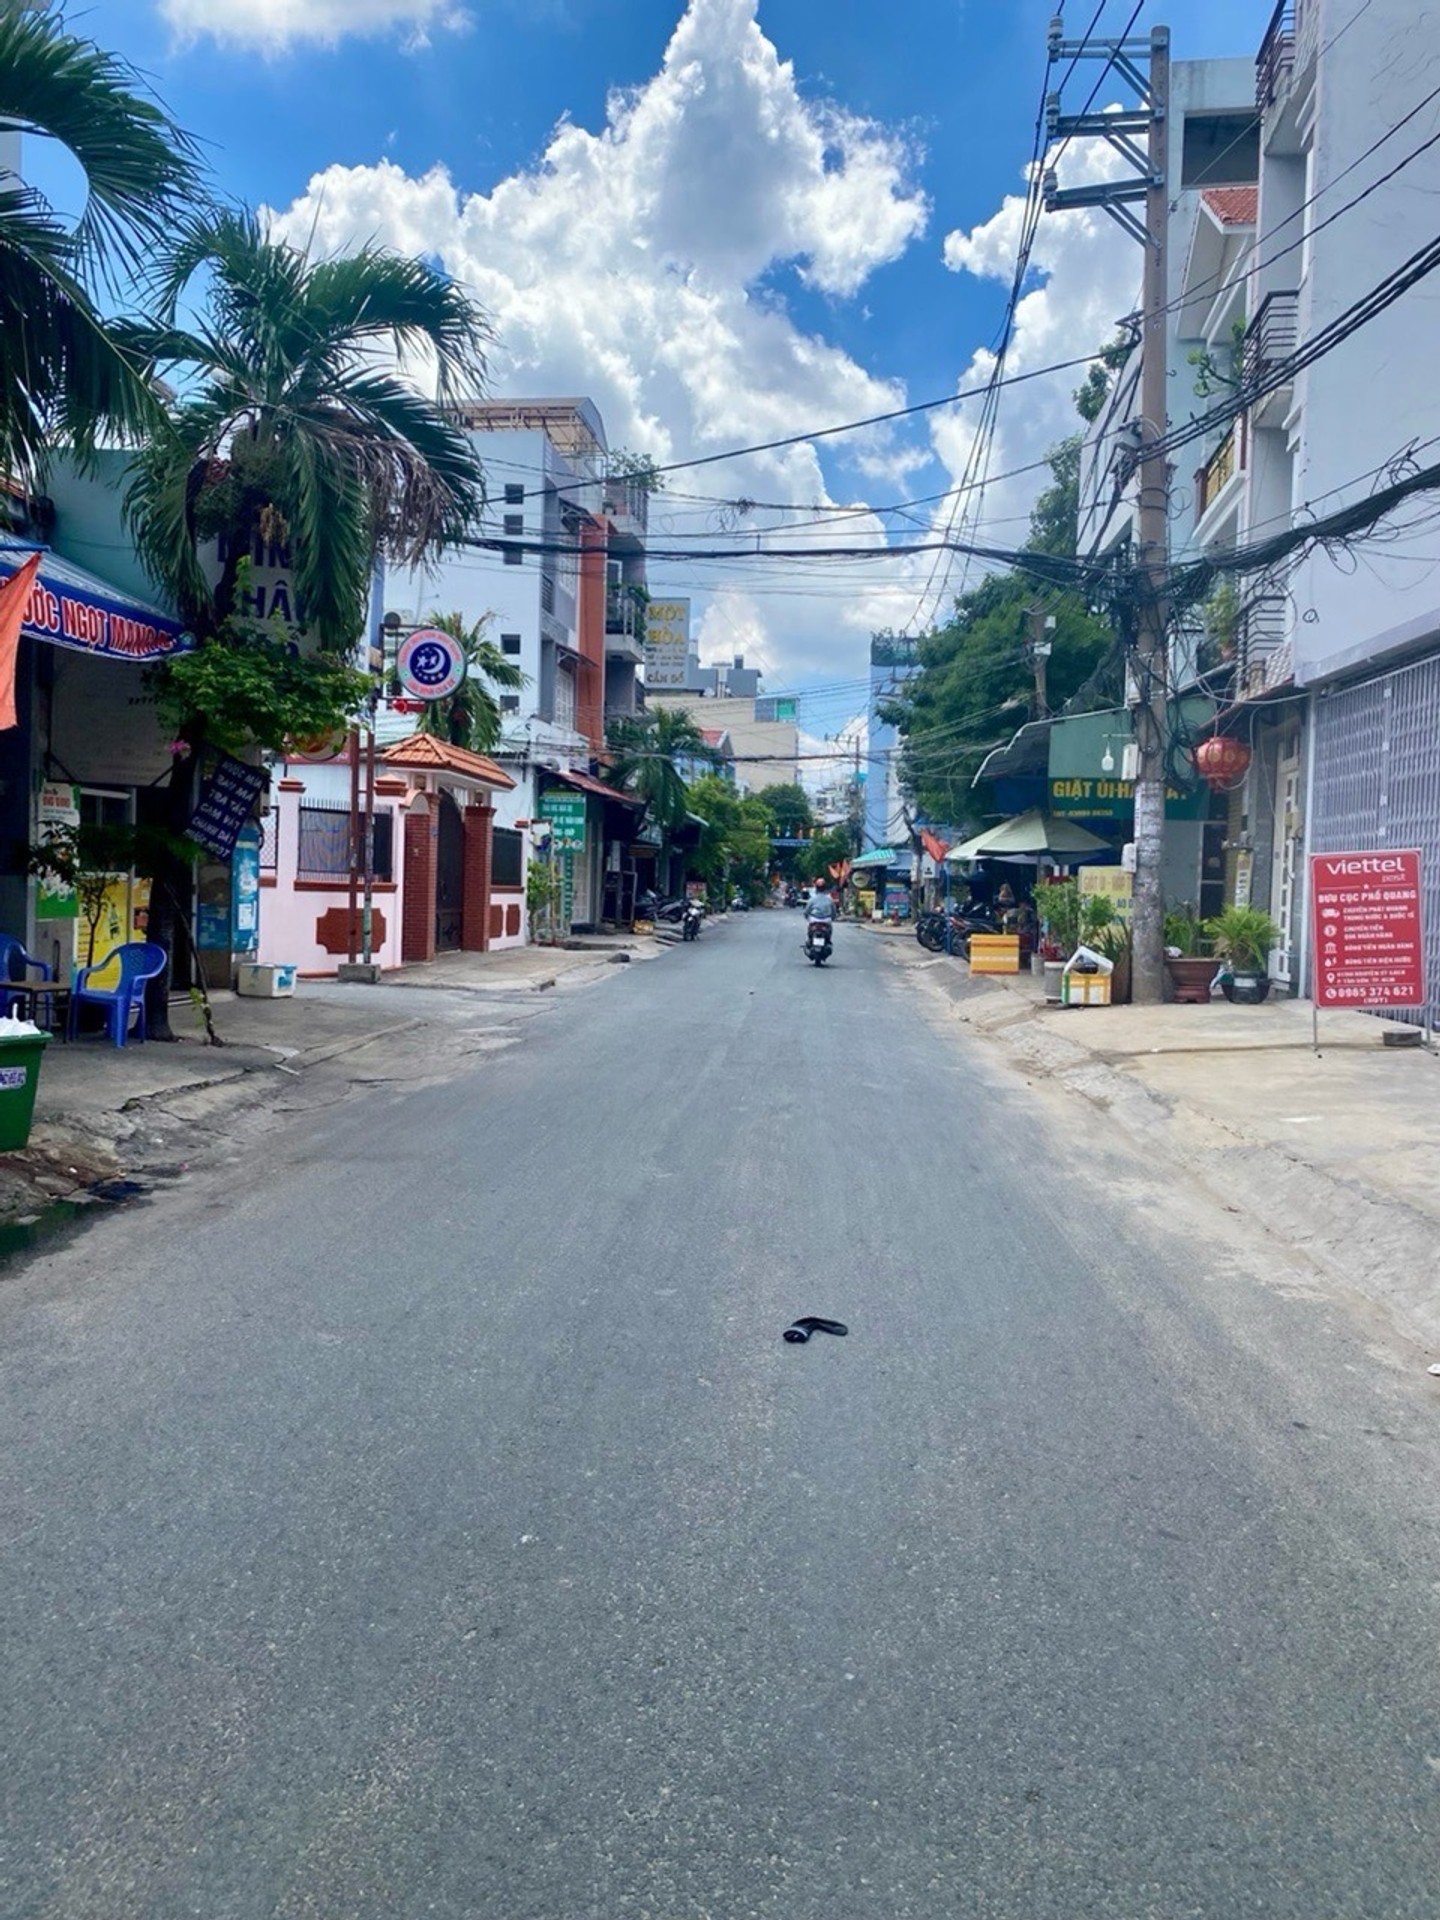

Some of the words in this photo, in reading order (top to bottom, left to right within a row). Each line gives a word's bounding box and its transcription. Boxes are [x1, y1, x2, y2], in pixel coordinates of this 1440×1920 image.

[60, 595, 108, 650] NGỌT
[1052, 779, 1093, 800] GIẶT
[1326, 857, 1405, 875] viettel
[1382, 873, 1406, 883] post
[1340, 892, 1359, 904] CỤC
[1361, 889, 1381, 901] PHỐ
[1383, 889, 1416, 901] QUANG
[1369, 986, 1391, 996] 374
[1392, 985, 1414, 996] 621
